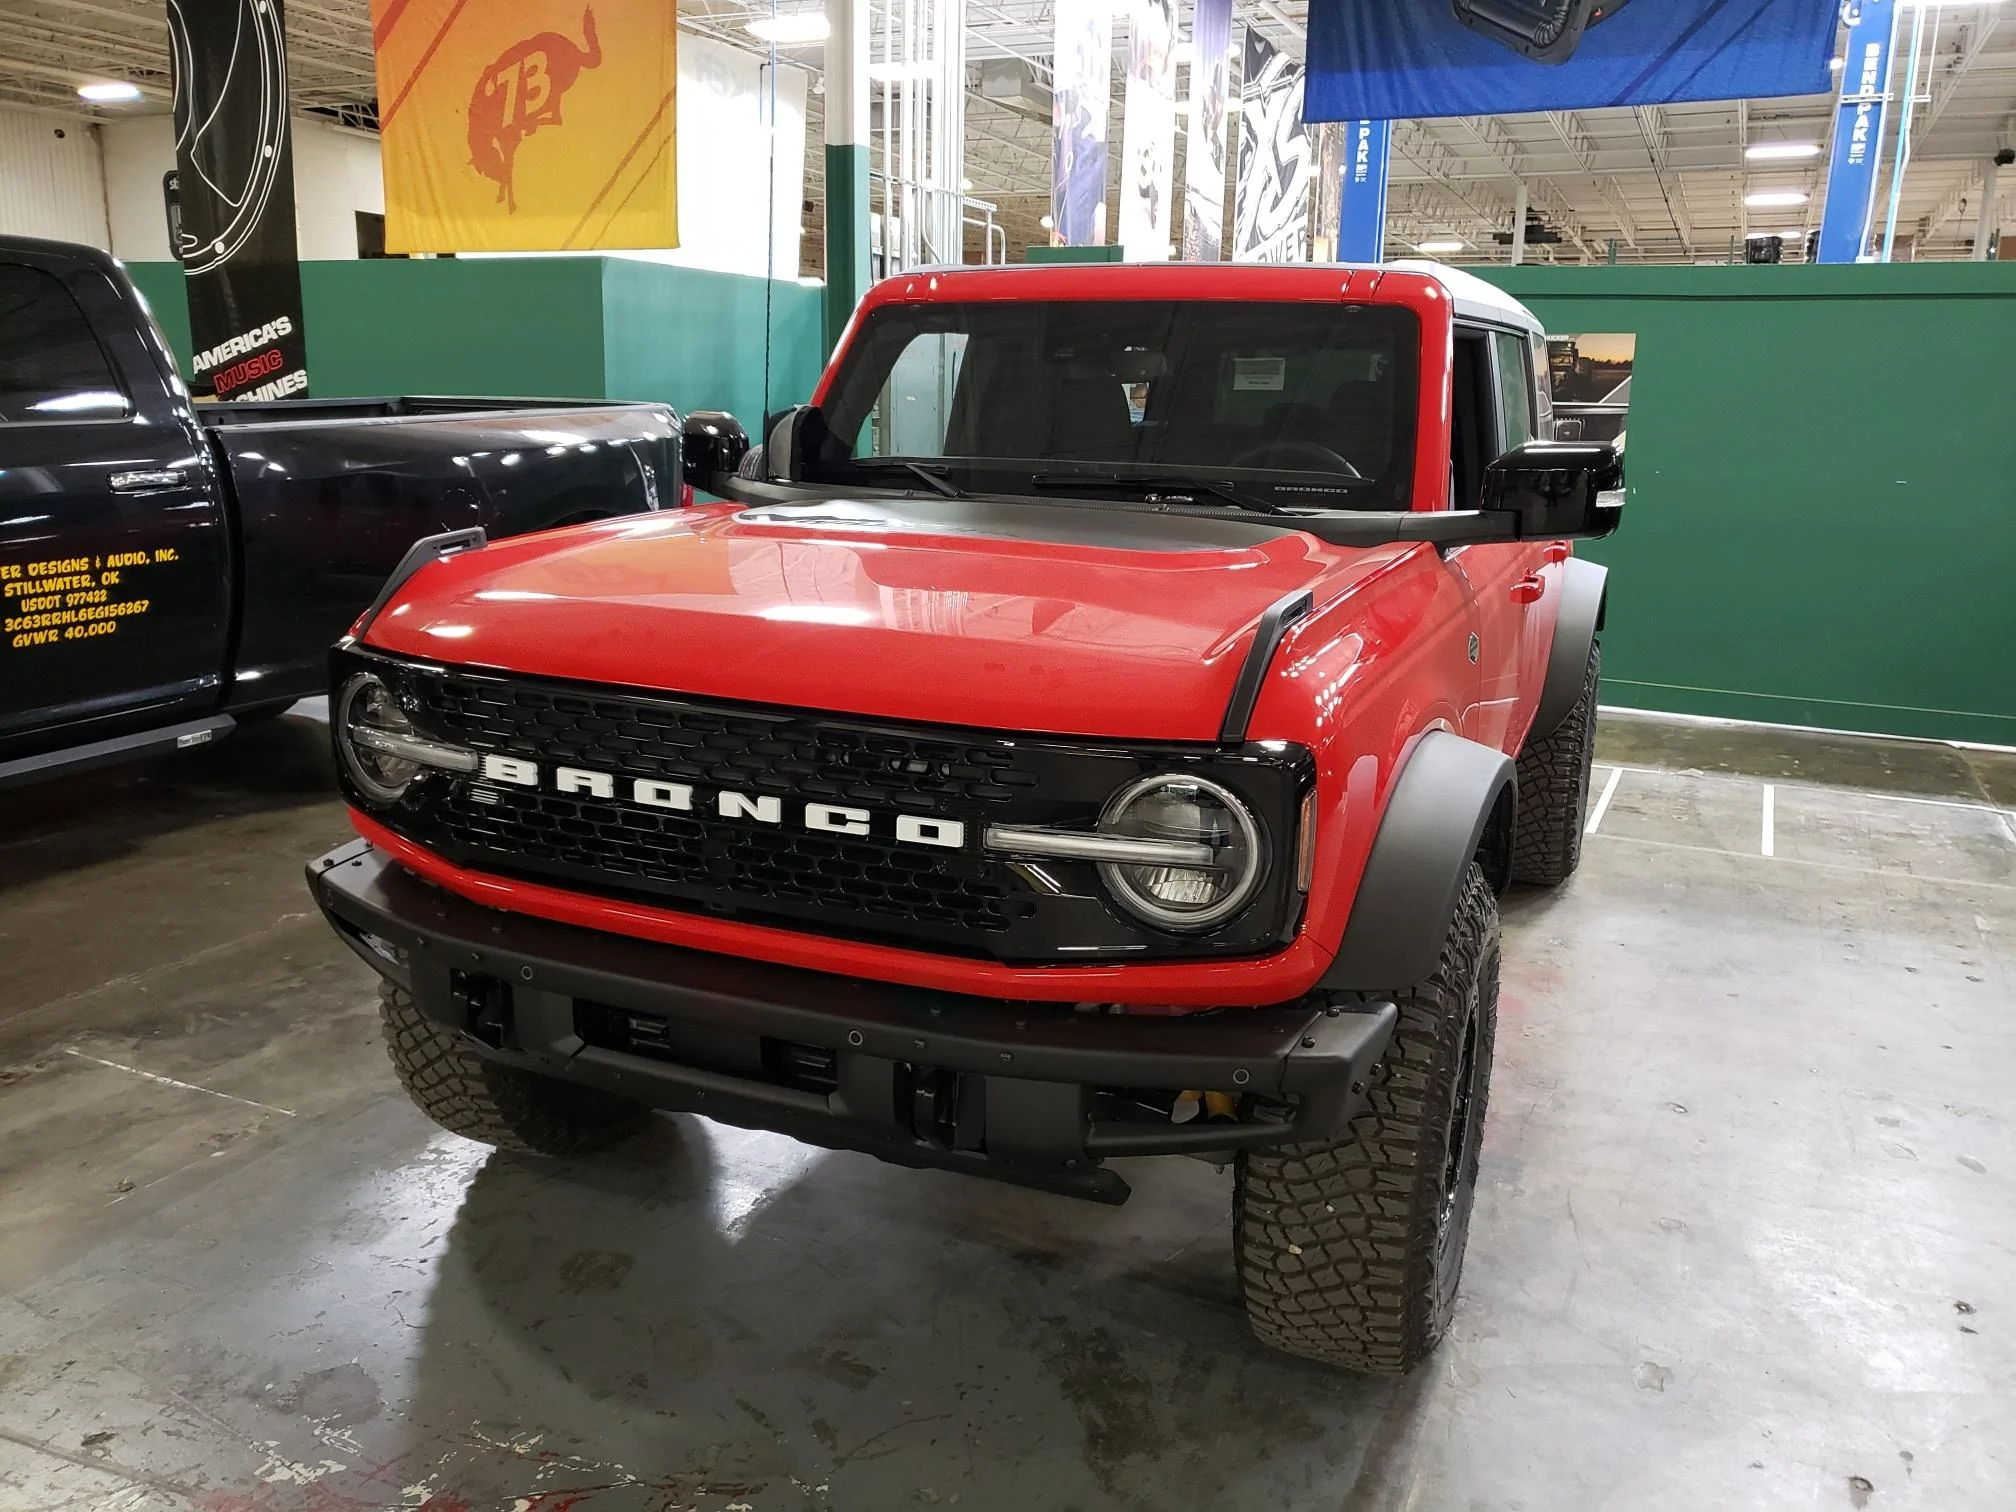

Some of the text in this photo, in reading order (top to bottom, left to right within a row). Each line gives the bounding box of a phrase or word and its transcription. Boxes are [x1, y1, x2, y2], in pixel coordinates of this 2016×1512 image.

[193, 316, 292, 375] AMERICA'S
[213, 349, 283, 394] MUSIC
[0, 564, 21, 580] ER
[28, 557, 89, 577] DESIGNS
[107, 551, 150, 568] AUDIO,
[155, 548, 179, 562] INC.
[4, 571, 120, 598] STILLWATER, OK
[21, 589, 107, 613] USDOT 977422
[13, 621, 116, 648] GVWR 40,000
[485, 754, 965, 848] BRONCO
